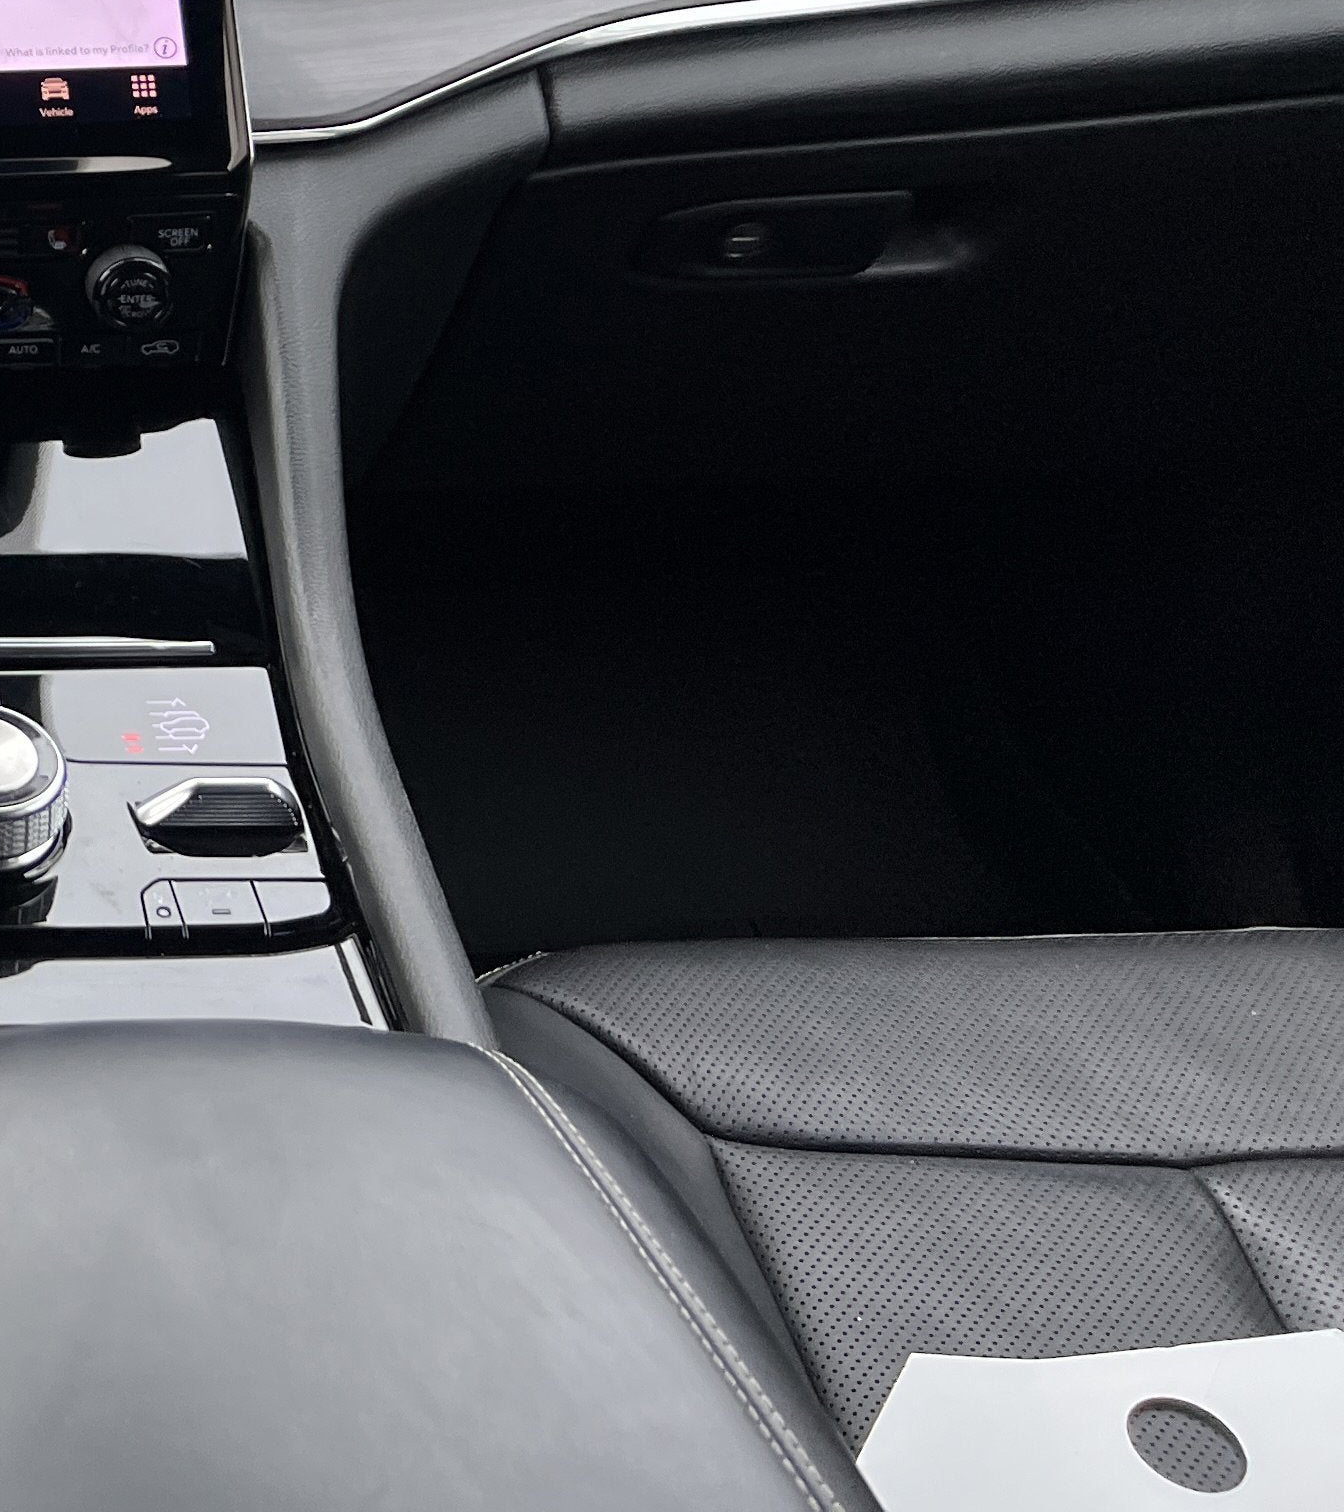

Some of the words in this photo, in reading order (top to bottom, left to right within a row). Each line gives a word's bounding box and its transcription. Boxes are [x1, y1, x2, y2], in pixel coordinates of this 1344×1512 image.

[4, 46, 33, 58] What
[35, 46, 43, 57] is
[45, 45, 77, 57] linked
[79, 45, 90, 56] to
[92, 47, 108, 58] my
[110, 42, 149, 56] Profile?
[38, 106, 74, 118] Vehicle
[133, 104, 158, 116] Apps
[157, 228, 199, 239] SCREEN
[170, 237, 191, 247] OFF
[9, 345, 39, 355] AUTO
[80, 344, 101, 354] A/C
